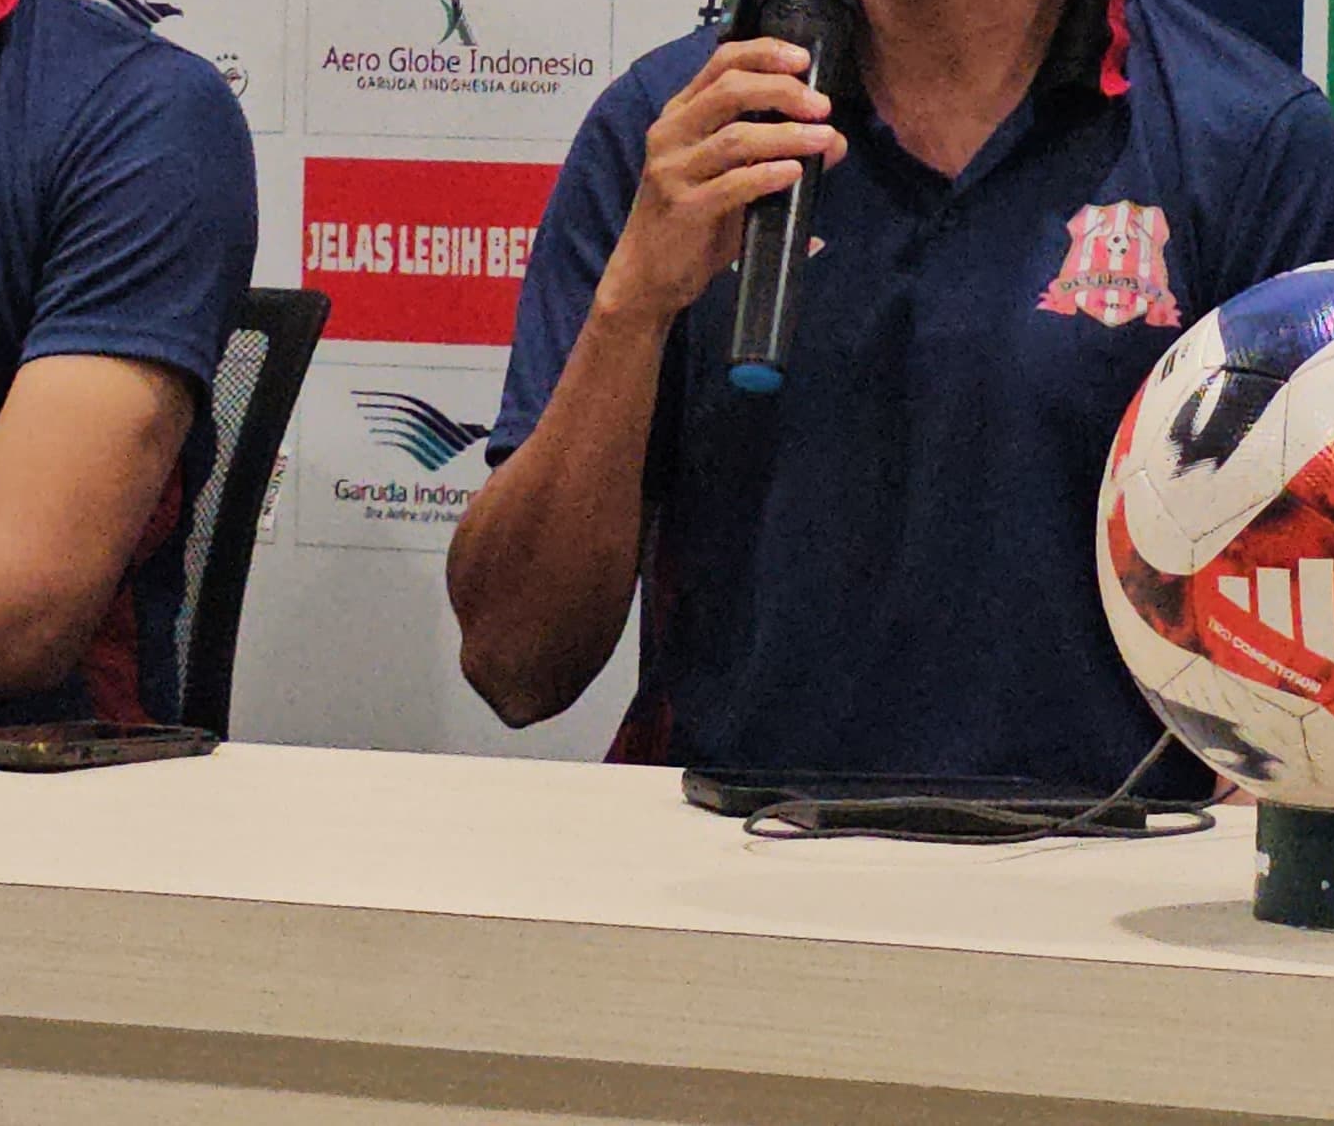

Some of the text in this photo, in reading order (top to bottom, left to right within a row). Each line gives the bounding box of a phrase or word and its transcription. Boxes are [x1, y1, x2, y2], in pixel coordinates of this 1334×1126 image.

[323, 47, 593, 76] Aero Globe Indonesia
[307, 224, 392, 271] JELAS
[399, 226, 482, 276] LEBIH
[334, 478, 469, 506] Garuda Indon
